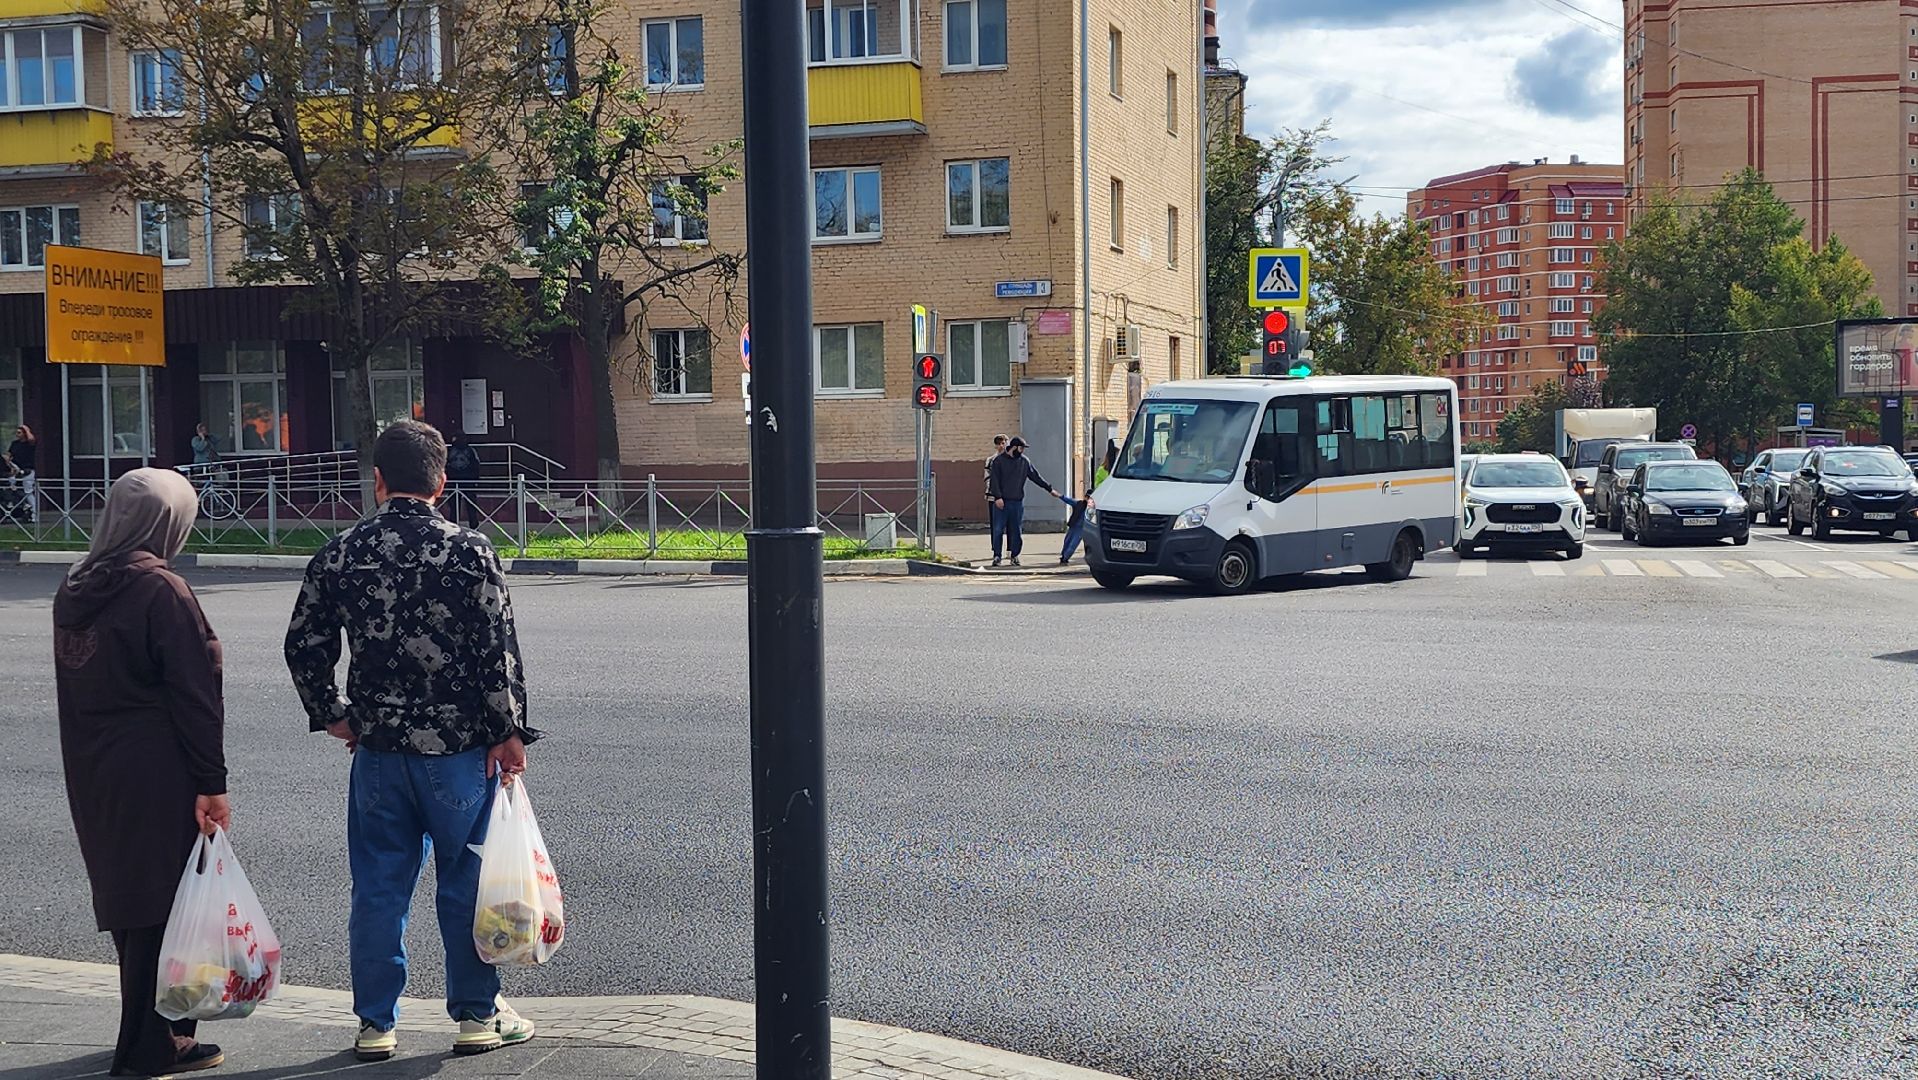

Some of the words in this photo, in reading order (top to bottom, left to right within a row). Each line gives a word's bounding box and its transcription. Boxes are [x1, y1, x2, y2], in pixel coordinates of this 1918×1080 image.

[52, 264, 159, 294] ВНИМАНИЕ!!!
[59, 298, 105, 319] Впереди
[108, 303, 153, 320] тросовое
[71, 329, 133, 344] ограждение
